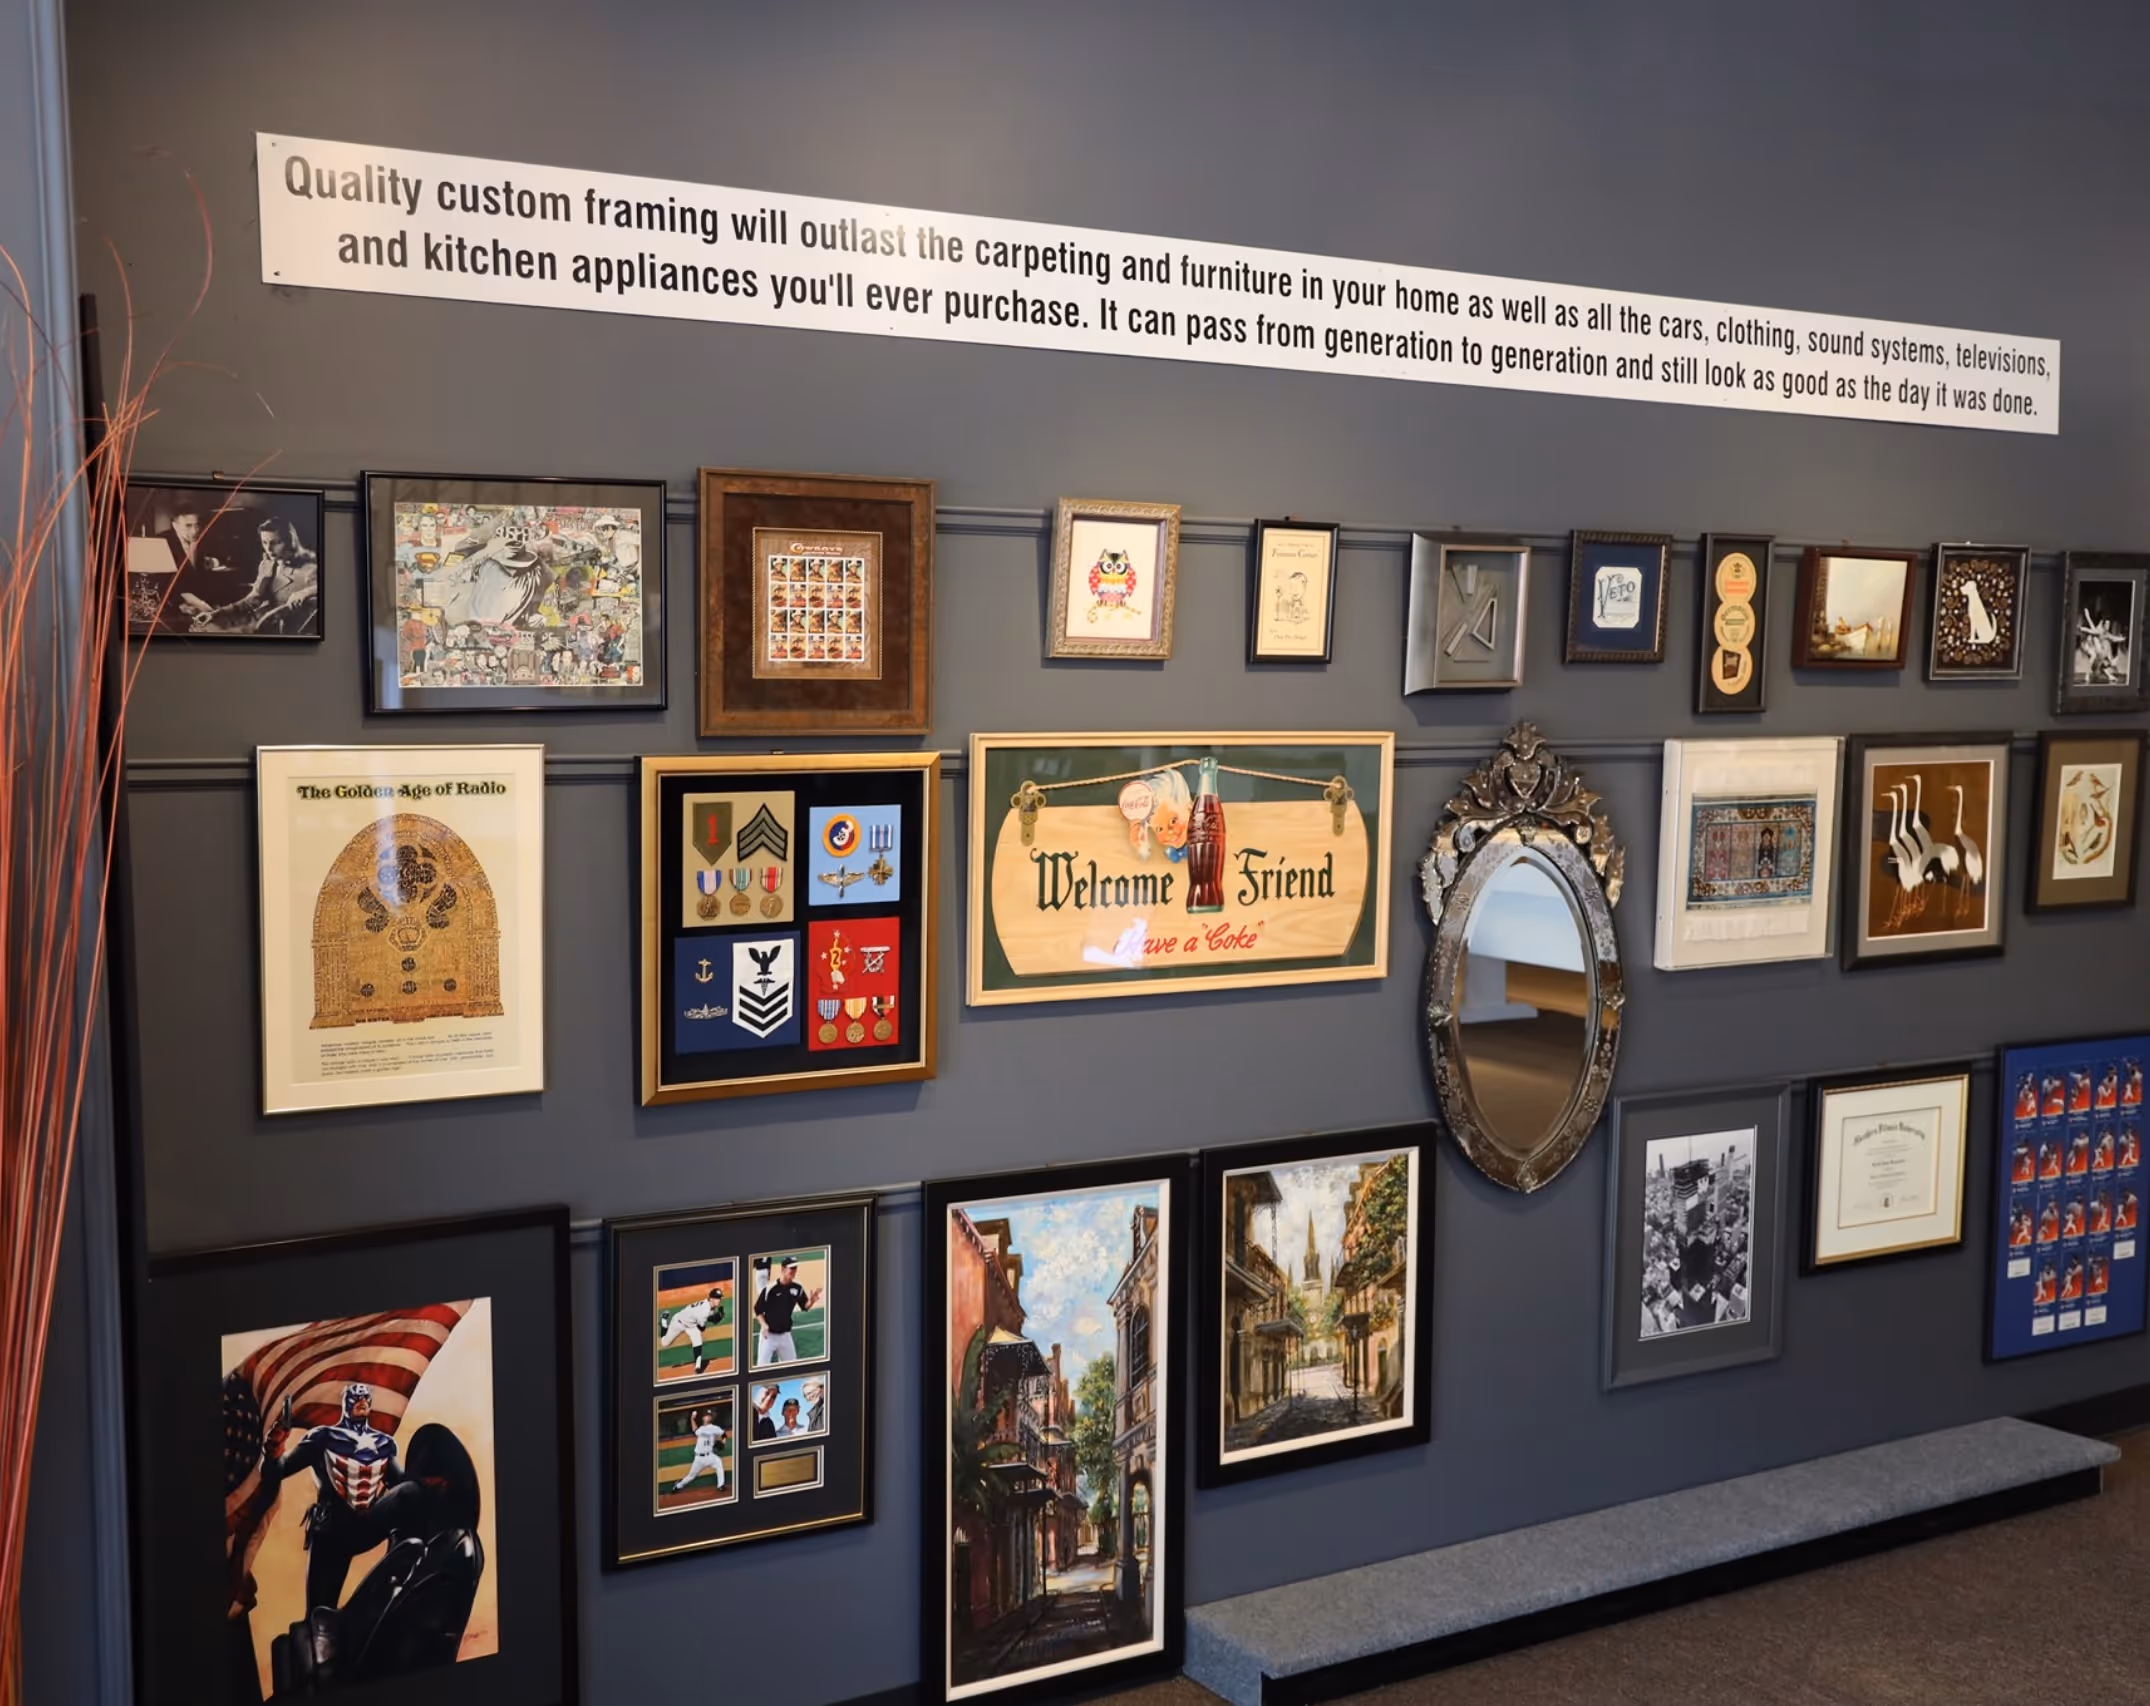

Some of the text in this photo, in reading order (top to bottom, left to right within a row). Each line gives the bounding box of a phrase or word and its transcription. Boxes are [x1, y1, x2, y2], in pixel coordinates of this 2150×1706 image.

[285, 155, 2050, 380] Quality custom framing will outlast the carpeting and furniture in your home as well as all the cars, clothing, sound systems, televisions,
[338, 230, 2037, 416] and kitchen appliances you'll ever purchase. It can pass from generation to generation and still look as good as the day it was done.
[296, 780, 506, 800] The Golden Age of Radio
[1030, 847, 1337, 911] Welcome Friend
[1183, 934, 1198, 953] a
[1201, 919, 1264, 951] "Coke"
